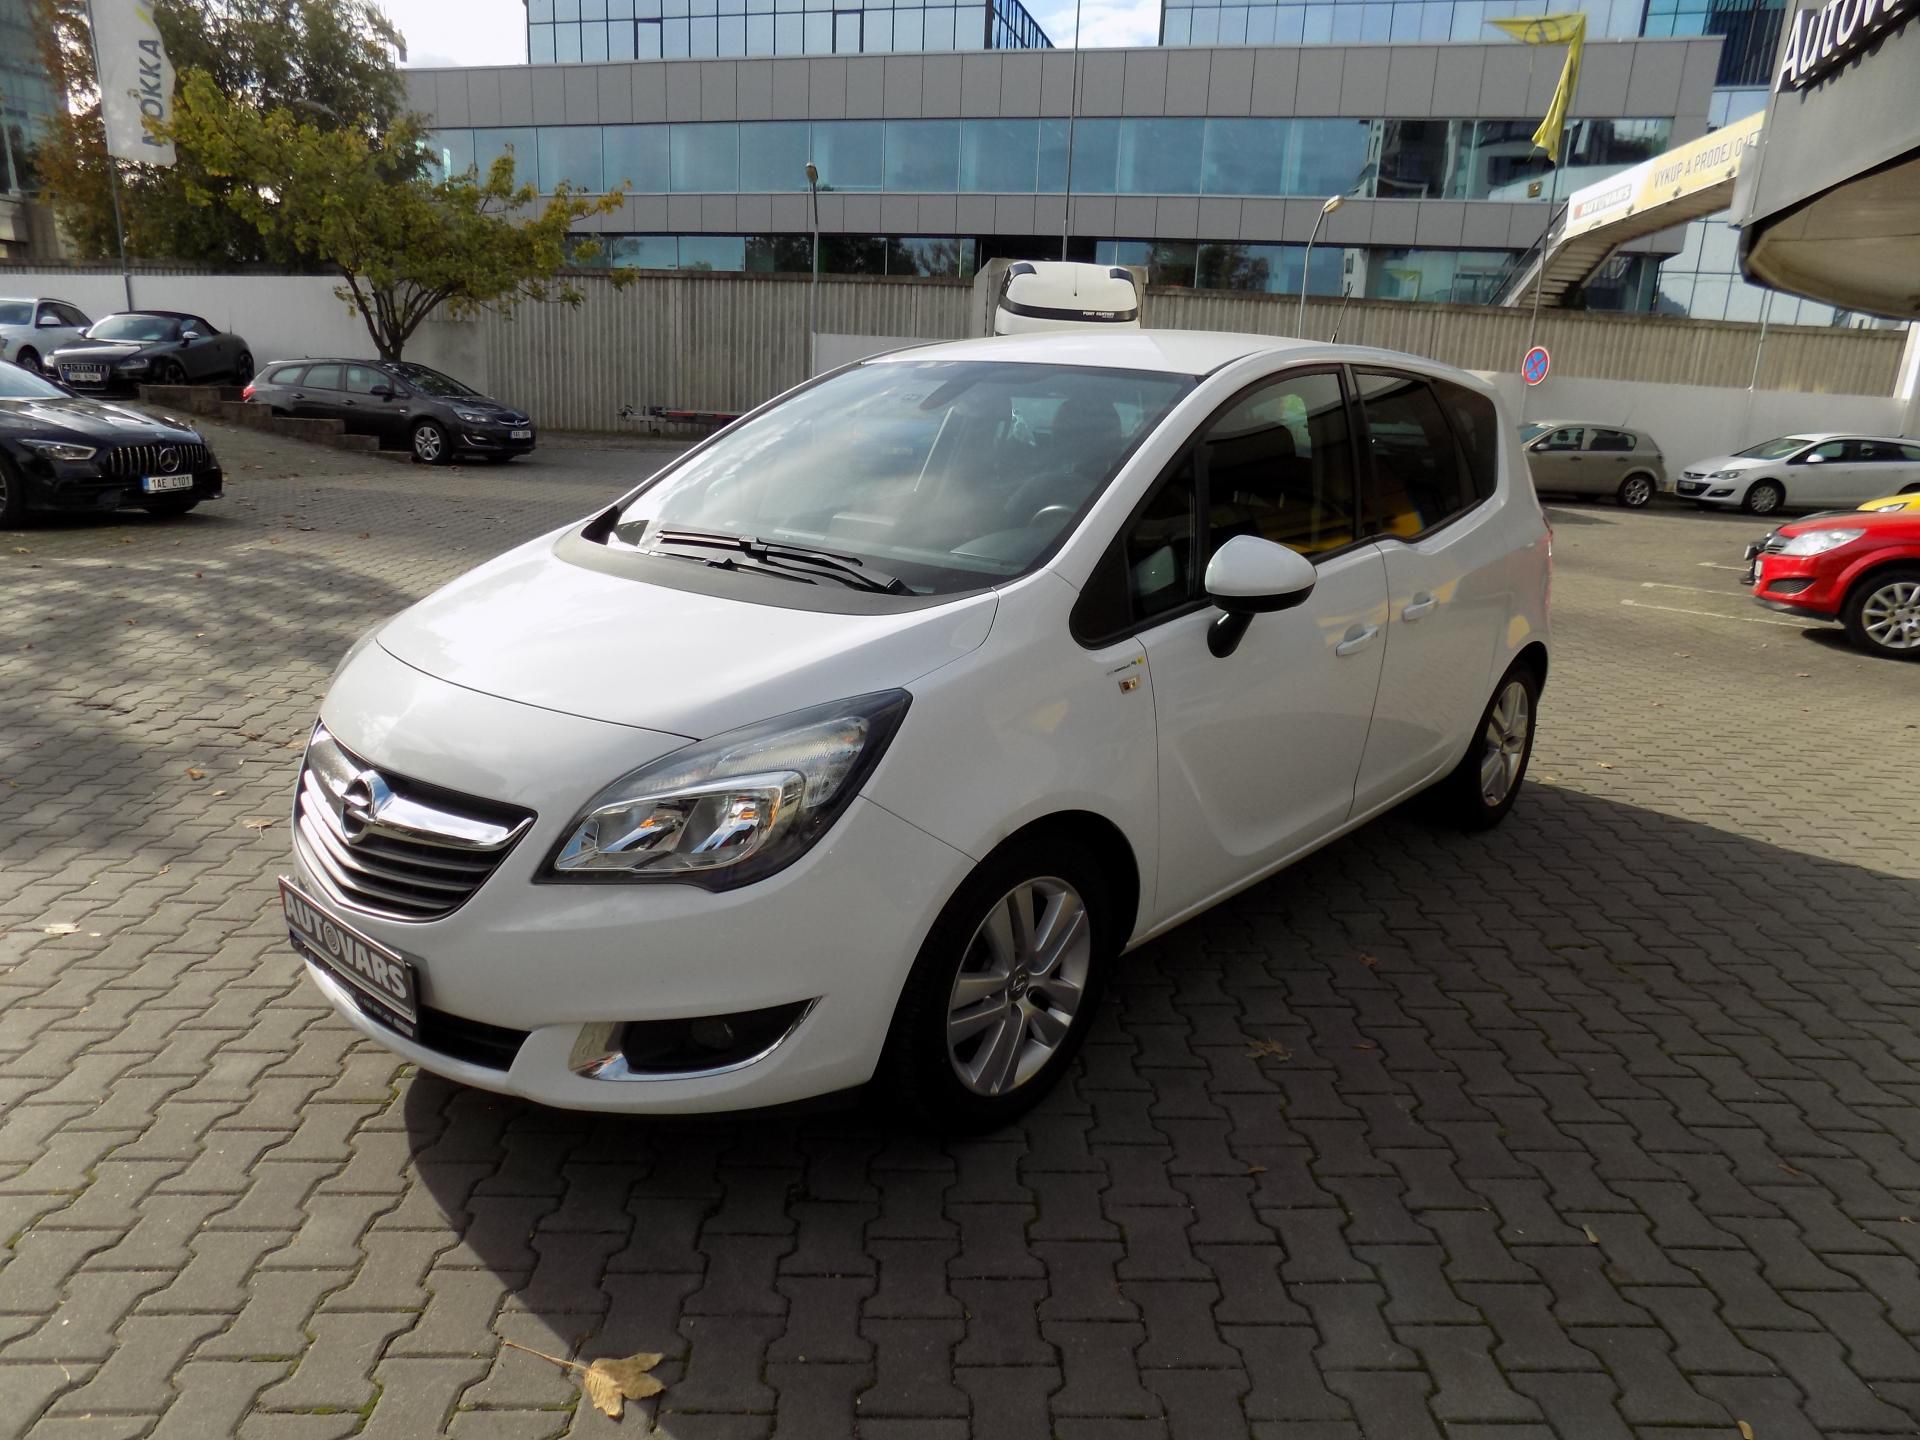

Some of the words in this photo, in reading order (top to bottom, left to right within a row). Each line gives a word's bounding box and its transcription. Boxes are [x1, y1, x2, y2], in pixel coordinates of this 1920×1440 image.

[1654, 163, 1682, 188] VYKUP
[1684, 160, 1692, 177] A
[1694, 141, 1732, 173] PRODEJ
[285, 891, 407, 999] AUTOVARS
